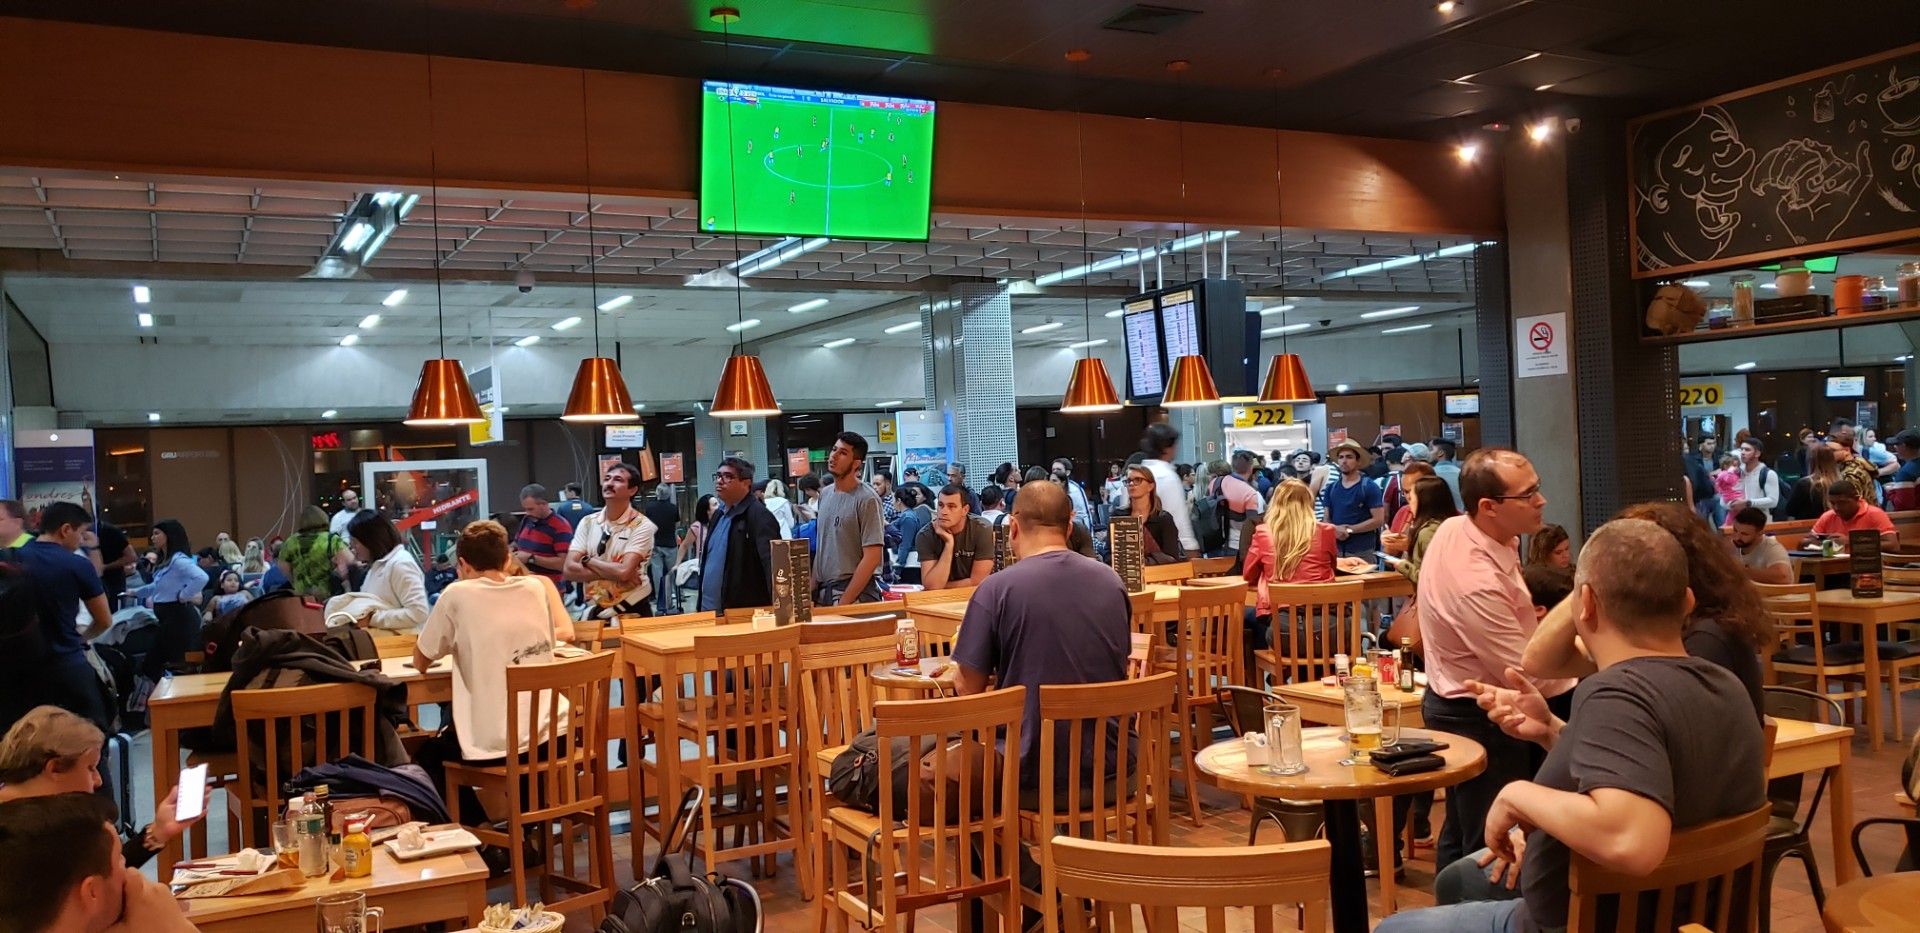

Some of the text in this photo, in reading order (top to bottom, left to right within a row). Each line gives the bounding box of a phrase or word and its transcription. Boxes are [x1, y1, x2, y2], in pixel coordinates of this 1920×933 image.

[1680, 387, 1718, 406] 220
[1253, 409, 1286, 426] 222
[433, 493, 472, 515] HIDRANTE
